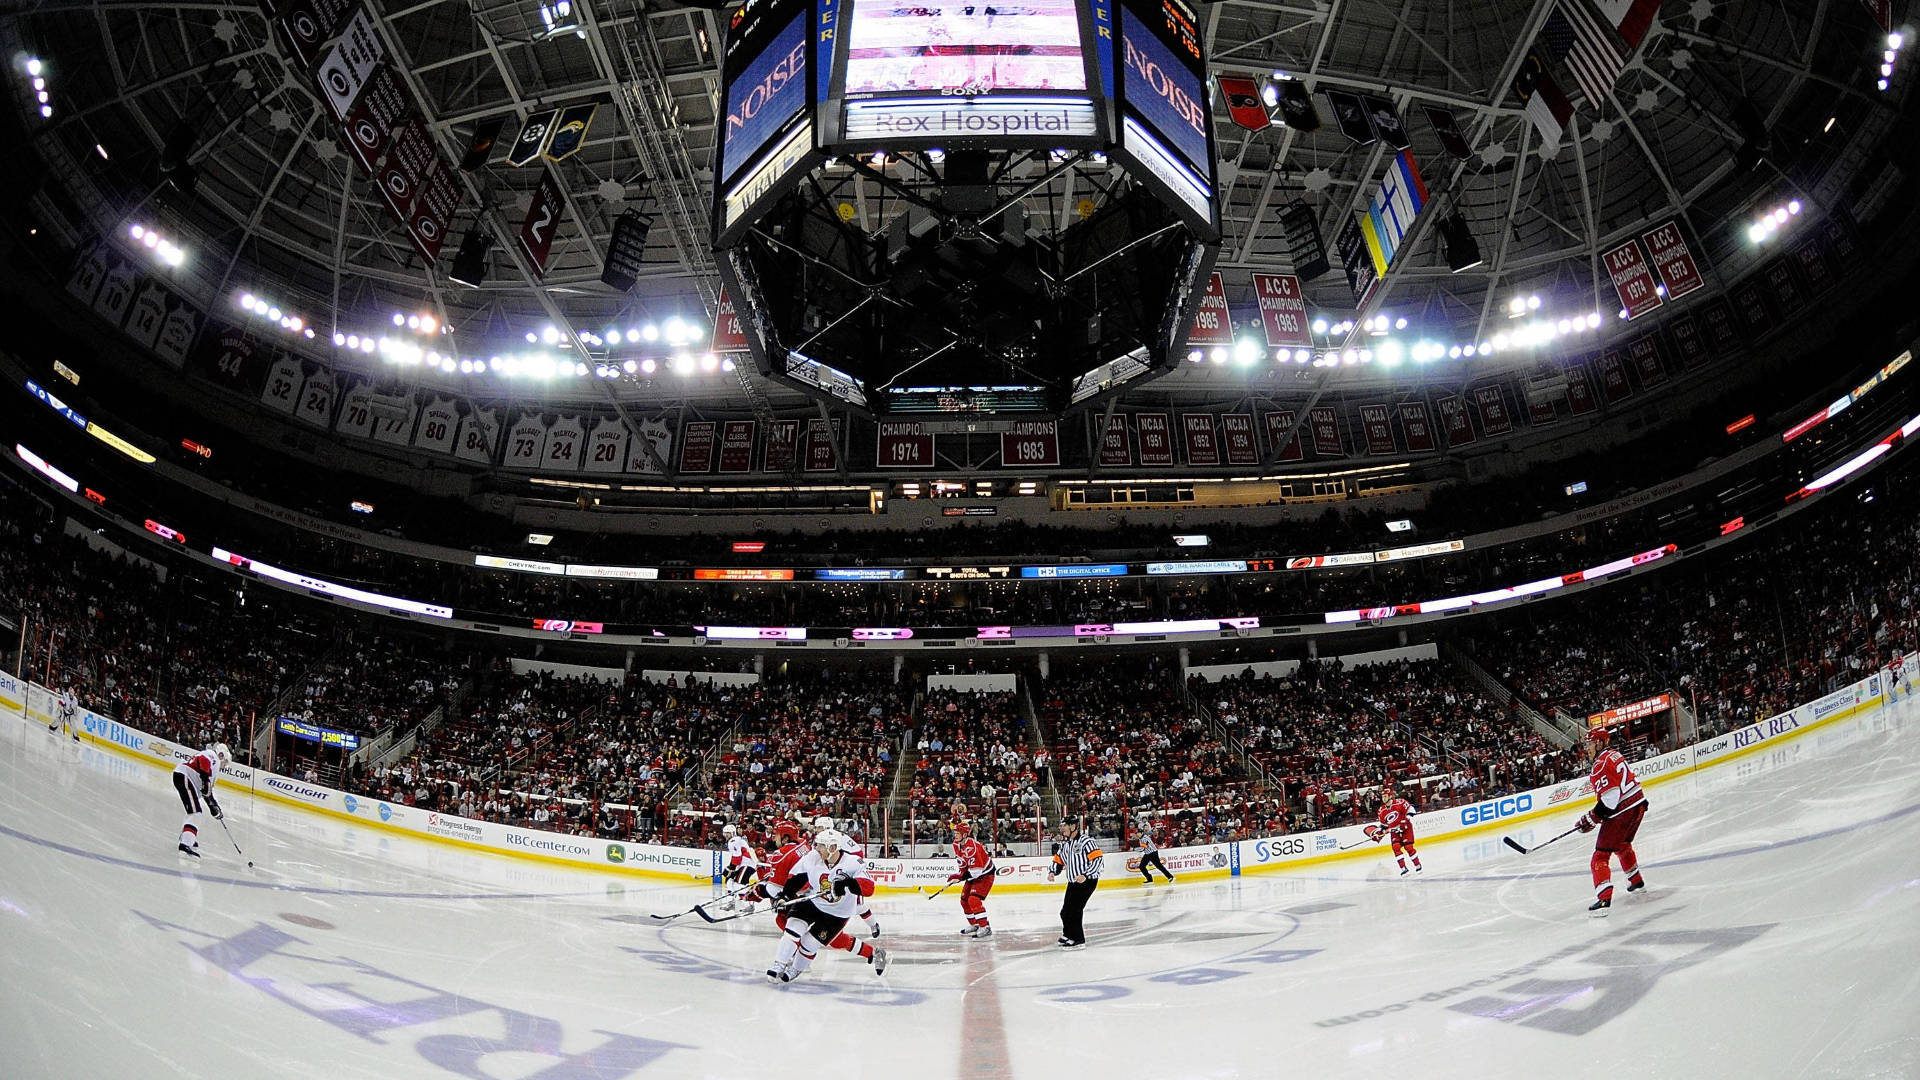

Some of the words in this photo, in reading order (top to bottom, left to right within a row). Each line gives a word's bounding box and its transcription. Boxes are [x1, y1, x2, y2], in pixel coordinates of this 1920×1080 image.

[725, 39, 806, 144] NOISE
[941, 88, 991, 96] SONY
[1122, 35, 1206, 138] NOISE
[372, 88, 394, 124] DIVISION
[375, 76, 401, 117] SOUTHEAST
[364, 95, 390, 137] CHAMPIONS
[876, 113, 930, 132] Rex
[942, 109, 1070, 135] Hospital
[400, 137, 422, 174] DIVISION
[403, 128, 429, 167] SOUTHEAST
[394, 146, 420, 186] CHAMPIONS
[1136, 149, 1198, 209] rexhealth.com
[431, 174, 457, 211] SOUTHEAST
[531, 204, 551, 245] 2
[1652, 228, 1675, 250] ACC
[1612, 247, 1634, 269] ACC
[1654, 243, 1687, 266] CHAMPIONS
[1614, 261, 1647, 286] CHAMPIONS
[1668, 260, 1688, 281] 1973
[1265, 278, 1291, 295] ACC
[1627, 279, 1647, 300] 1974
[1261, 297, 1303, 311] CHAMPIONS
[1195, 312, 1219, 329] 1985
[1274, 313, 1299, 332] 1983
[218, 352, 243, 378] 44
[280, 367, 295, 378] CARR
[272, 379, 292, 400] 32
[306, 393, 327, 414] 24
[1402, 407, 1423, 419] NCAA
[348, 406, 368, 426] 70
[1141, 418, 1164, 430] NCAA
[1187, 418, 1211, 430] NCAA
[1226, 418, 1249, 430] NCAA
[1270, 416, 1292, 429] NCAA
[1310, 410, 1333, 422] NCAA
[1363, 409, 1386, 422] NCAA
[425, 421, 447, 441] 80
[466, 432, 485, 452] 84
[514, 439, 535, 457] 73
[550, 441, 573, 460] 24
[1016, 441, 1045, 460] 1983
[1146, 435, 1162, 448] 1951
[594, 443, 617, 462] 20
[813, 447, 830, 459] 1973
[891, 443, 919, 461] 1974
[1338, 554, 1373, 563] CAROLINAS
[0, 678, 16, 694] ank
[1814, 700, 1840, 715] Business
[1839, 695, 1854, 706] Class
[109, 723, 145, 750] Blue
[1733, 724, 1766, 750] REX
[1768, 711, 1800, 737] REX
[1697, 741, 1728, 758] NHL.COM
[219, 766, 251, 781] NHL.COM
[1633, 754, 1686, 778] CAROLINAS
[268, 779, 293, 792] BUD
[294, 786, 330, 801] LIGHT
[1595, 774, 1609, 793] 25
[1461, 794, 1533, 826] GEICO
[427, 826, 483, 842] progress-energy.com
[439, 818, 463, 830] Progress
[464, 822, 483, 835] Energy
[1271, 838, 1305, 857] sas
[1316, 838, 1338, 846] POWER
[629, 851, 660, 864] JOHN
[662, 853, 701, 868] DEERE
[1168, 861, 1183, 870] BIG
[1184, 859, 1205, 868] FUN!
[1231, 842, 1239, 869] Reebok
